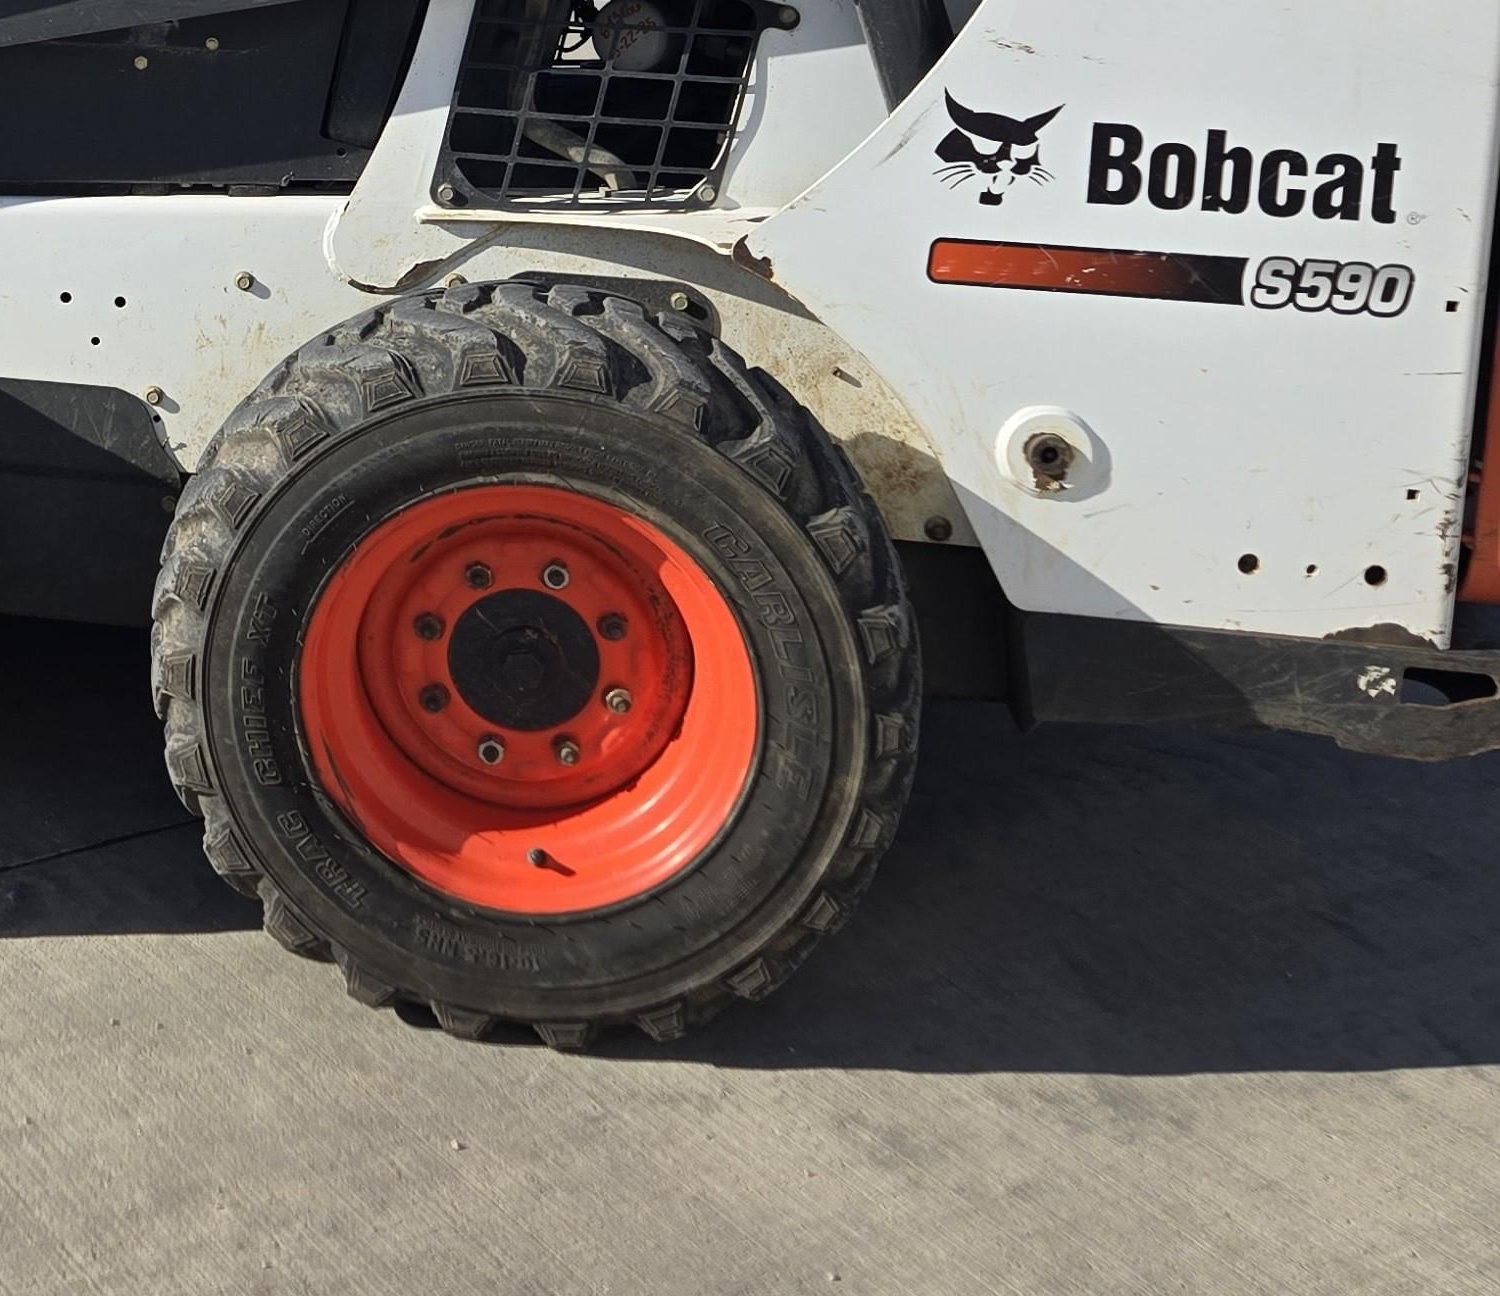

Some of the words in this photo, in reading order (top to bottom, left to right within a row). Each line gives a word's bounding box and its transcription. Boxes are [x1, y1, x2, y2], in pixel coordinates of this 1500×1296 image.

[1086, 122, 1402, 224] Bobcat
[1250, 255, 1416, 318] S590
[301, 495, 348, 536] DIRECTION
[246, 591, 279, 647] XT
[701, 520, 821, 801] CARLISLE
[240, 656, 282, 786] CHIEF
[276, 809, 369, 911] TRAC
